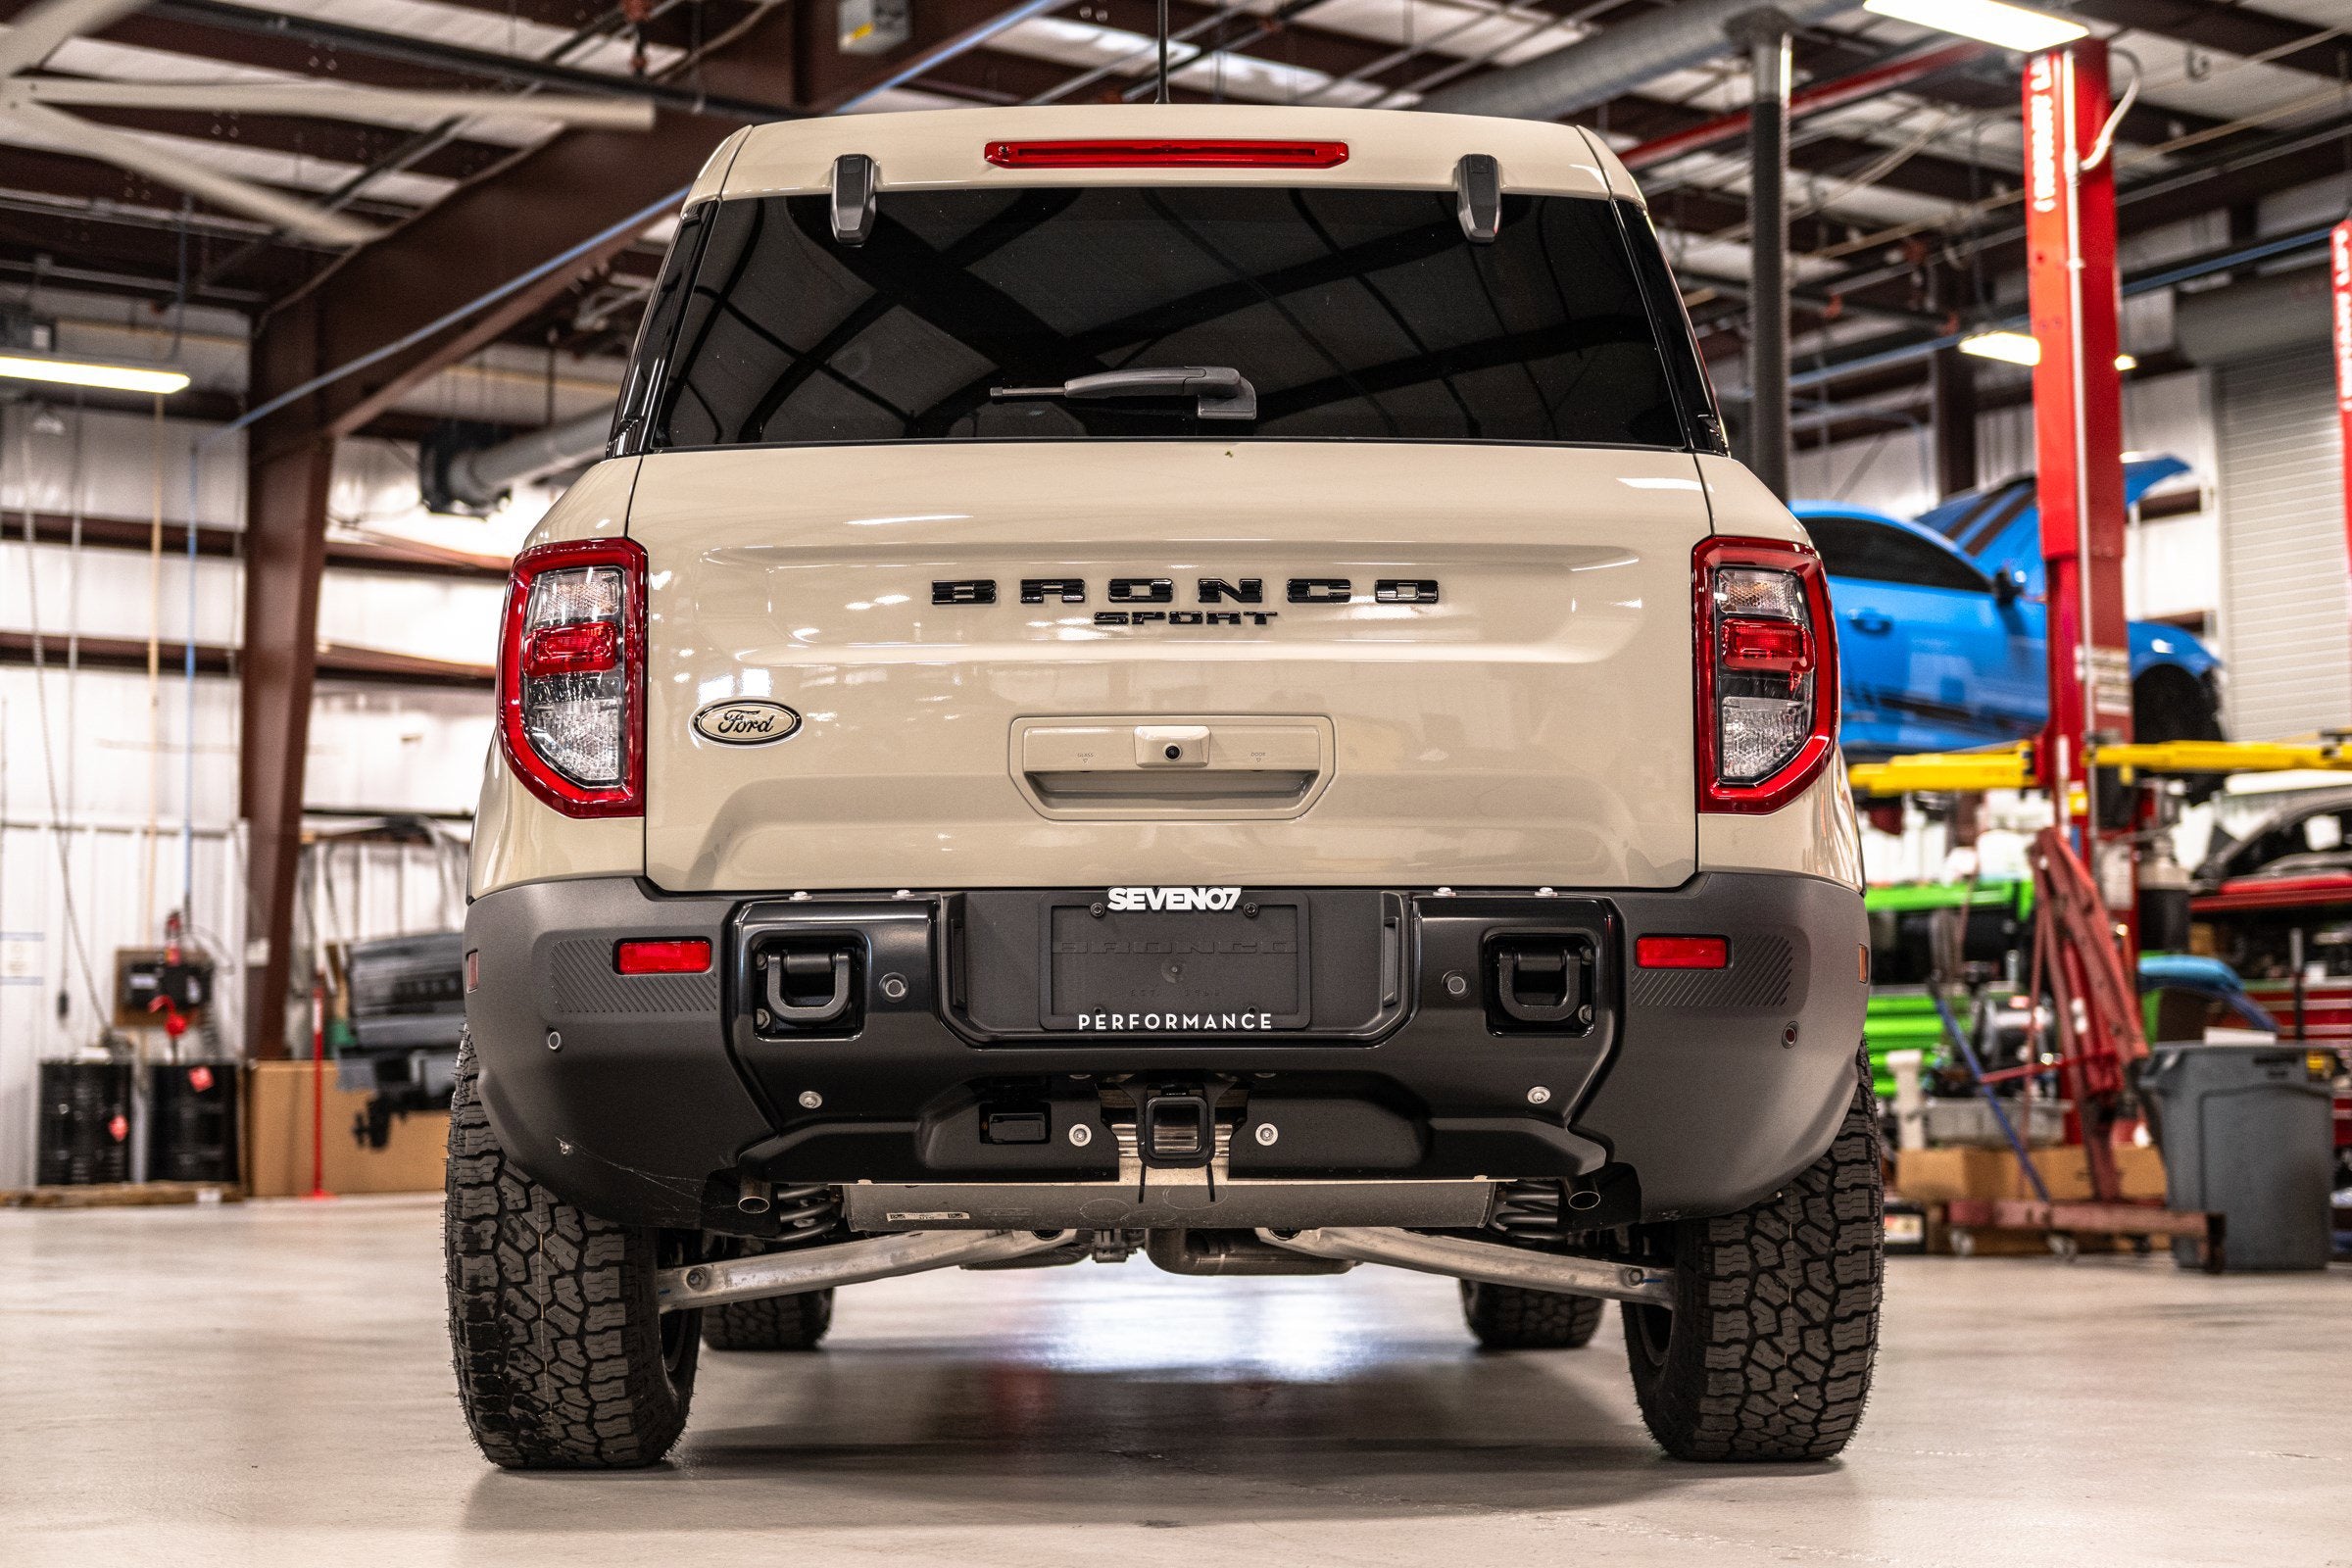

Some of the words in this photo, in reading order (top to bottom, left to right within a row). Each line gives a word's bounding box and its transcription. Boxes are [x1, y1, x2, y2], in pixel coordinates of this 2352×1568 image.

[931, 578, 1440, 604] BRONCO
[1093, 611, 1278, 625] SPORT
[717, 709, 774, 733] Ford
[1052, 940, 1298, 955] BRONCO
[1078, 1012, 1272, 1030] PERFORMANCE
